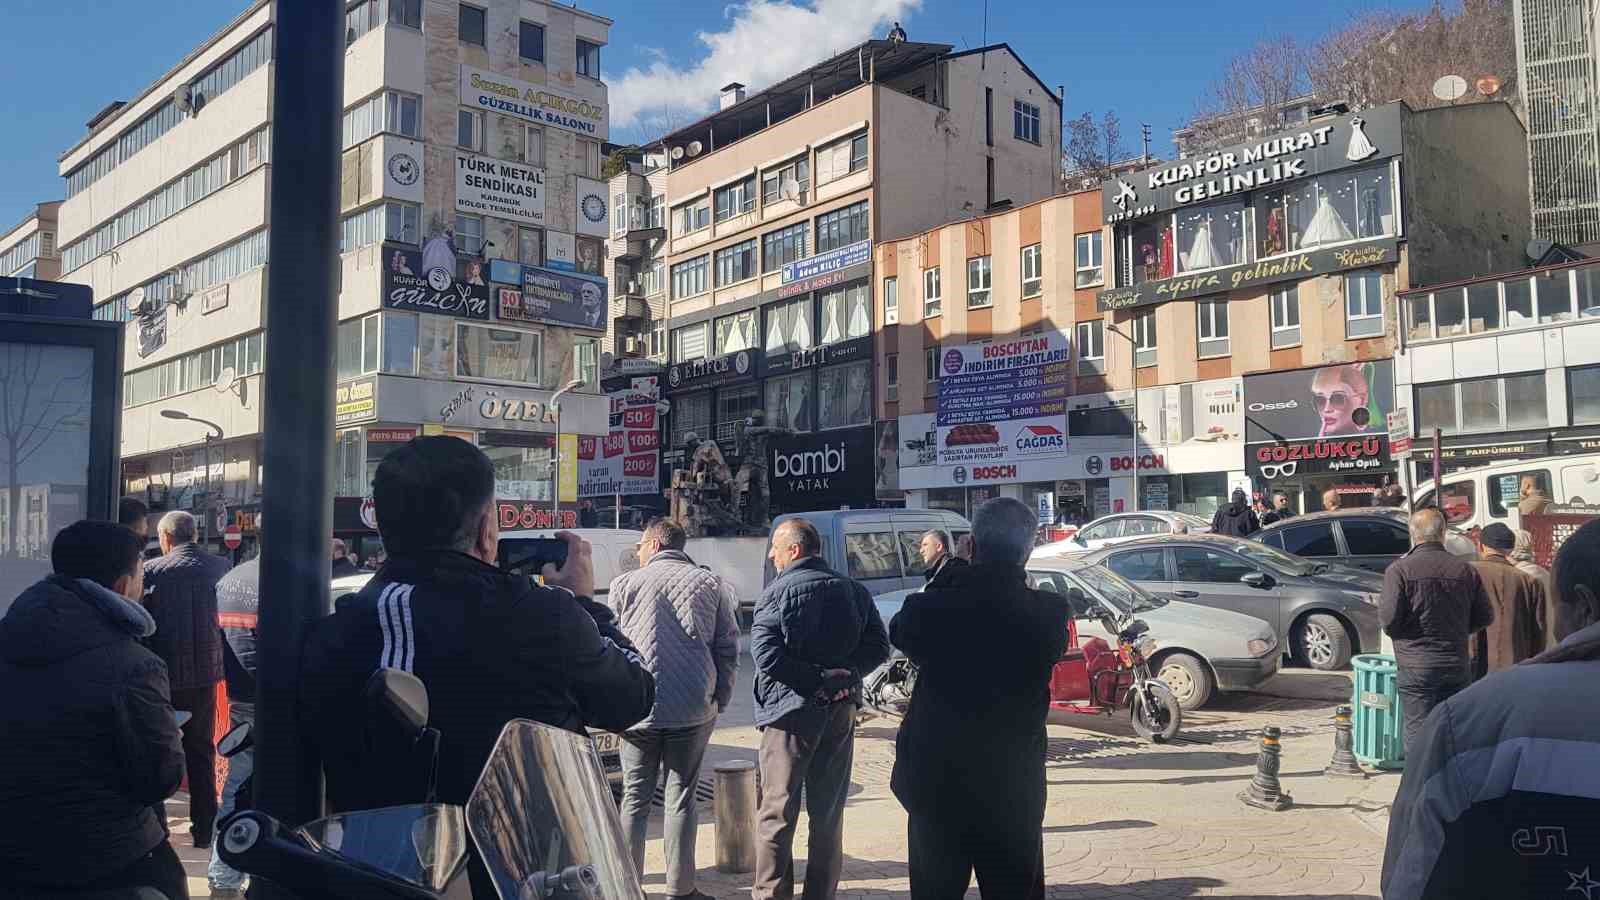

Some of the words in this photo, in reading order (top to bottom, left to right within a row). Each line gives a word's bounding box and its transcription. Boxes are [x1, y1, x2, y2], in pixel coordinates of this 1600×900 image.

[545, 112, 596, 133] SALONU
[1148, 150, 1237, 189] KUAFÖR
[1242, 126, 1333, 165] MURAT
[457, 155, 496, 175] TÜRK
[500, 166, 543, 185] METAL
[1174, 158, 1306, 203] GELİNLİK
[465, 174, 537, 198] SENDİKASI
[1136, 204, 1155, 216] 444
[1231, 254, 1313, 288] gelinlik
[983, 337, 1048, 358] BOSCH'TAN
[1007, 348, 1068, 368] FIRSATLARI!
[1248, 400, 1298, 412] Ossé
[774, 441, 845, 478] bambi
[1257, 436, 1379, 462] GÖZLÜKÇÜ
[973, 465, 1017, 480] BOSCH
[1110, 454, 1164, 471] BOSCH
[1328, 461, 1355, 471] Ayhan
[1355, 458, 1381, 469] Optik
[789, 478, 831, 491] YATAK
[597, 735, 612, 750] 78
